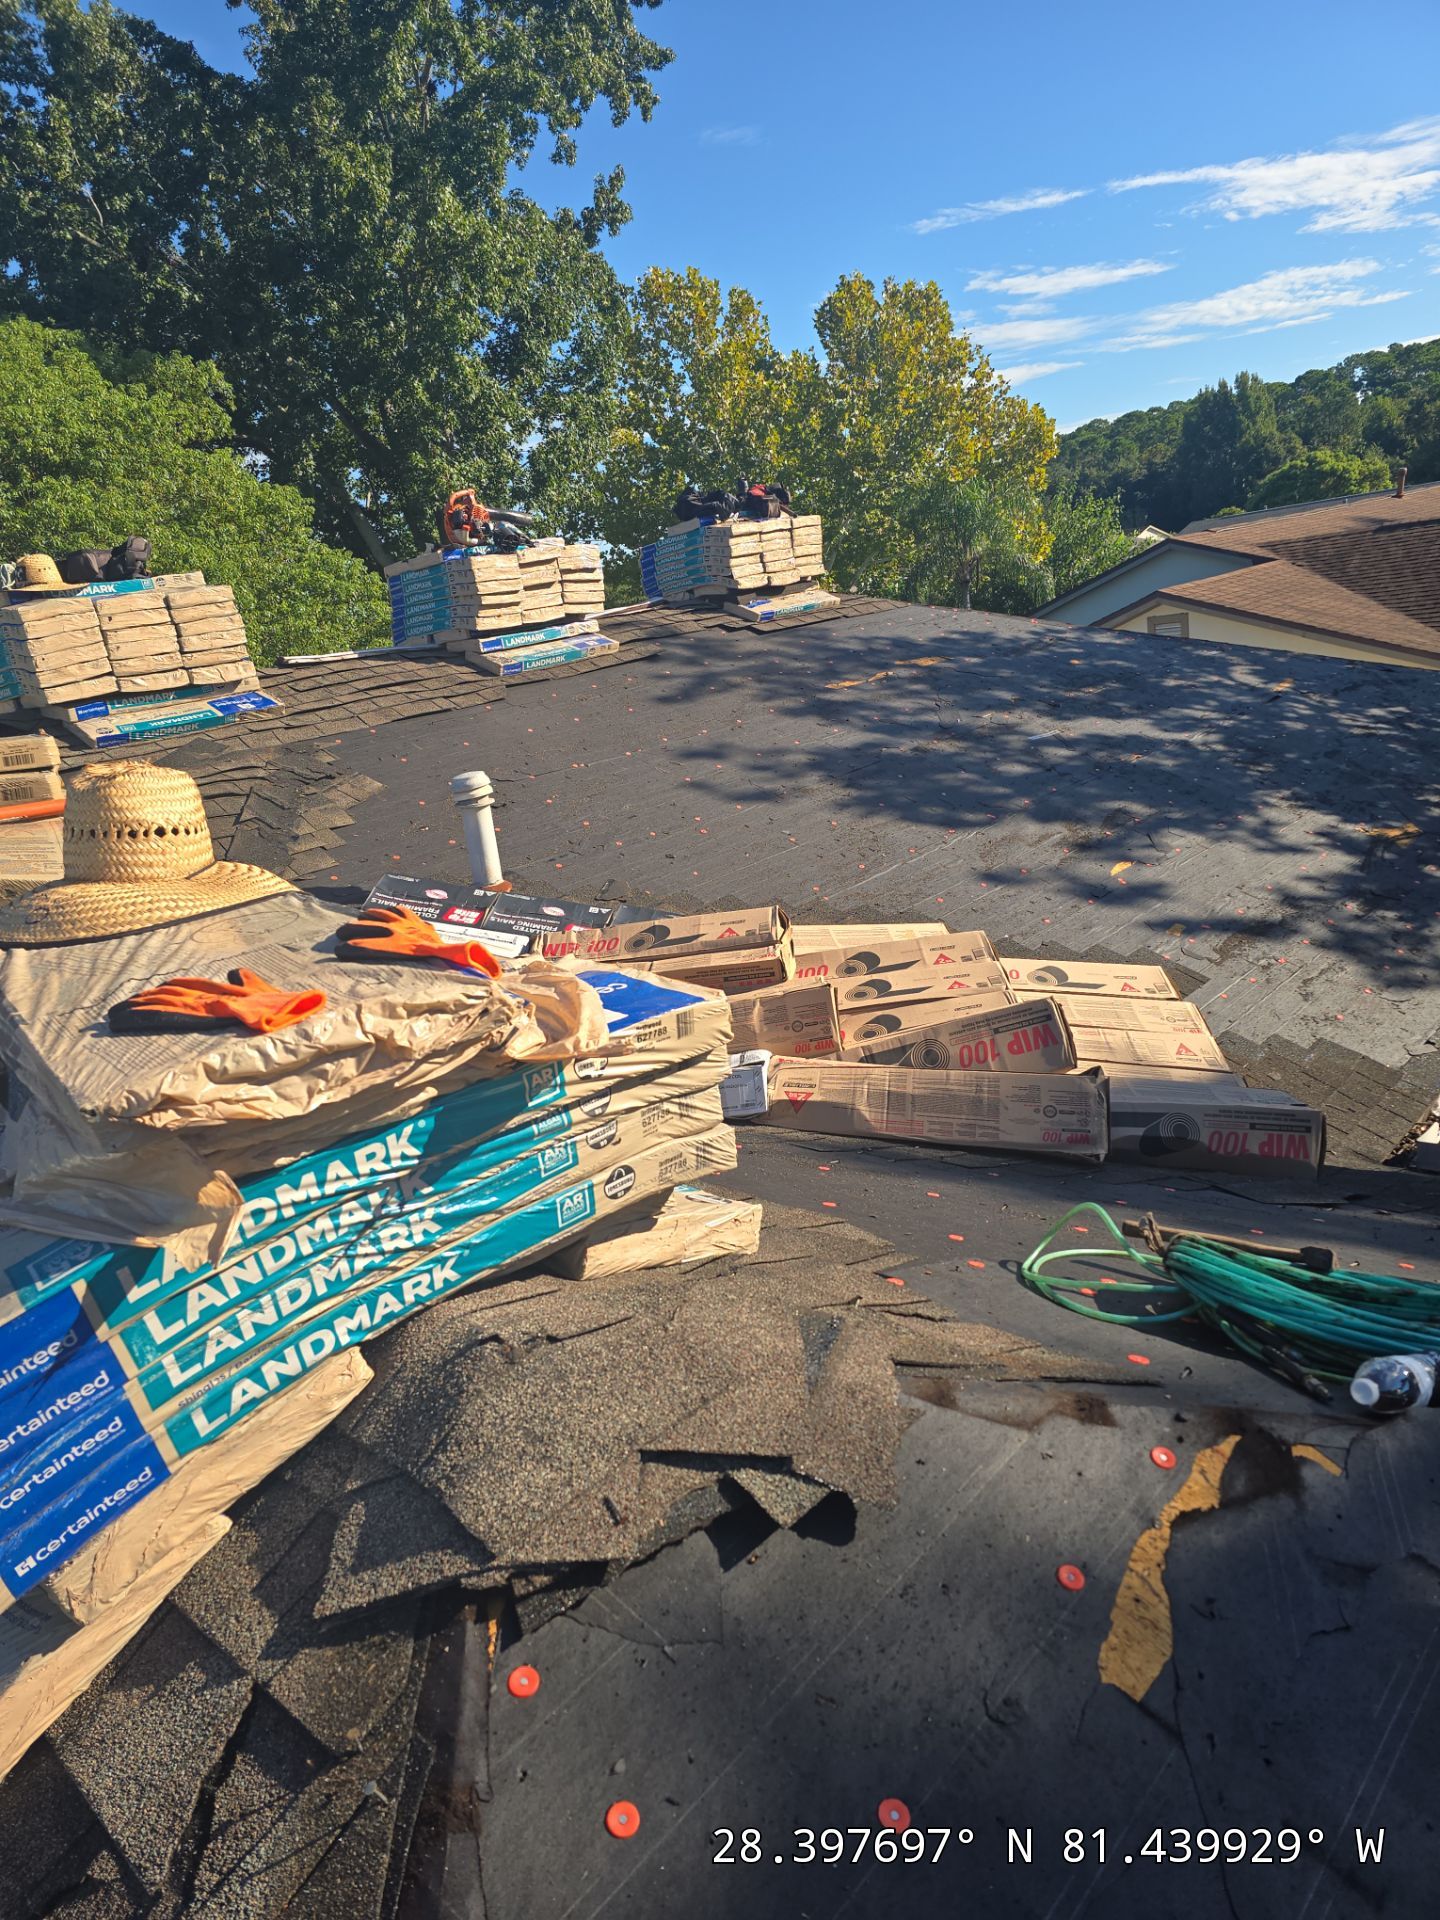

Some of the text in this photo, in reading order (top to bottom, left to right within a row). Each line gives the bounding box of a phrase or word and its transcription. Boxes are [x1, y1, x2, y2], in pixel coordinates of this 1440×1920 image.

[505, 632, 546, 647] LANDMARK
[526, 655, 566, 669] LANDMARK
[114, 691, 177, 708] LANDMARK
[135, 722, 200, 738] LANDMARK
[371, 897, 396, 907] NAILS
[491, 916, 516, 925] NAILS
[516, 920, 559, 932] FRAMING
[794, 1039, 835, 1055] WIP 100
[1006, 1023, 1059, 1056] WIP
[959, 1038, 1003, 1069] 100
[531, 1070, 554, 1088] AR
[1042, 1130, 1091, 1145] WIP 100
[1207, 1130, 1311, 1160] WIP 100
[562, 1192, 585, 1210] AR
[116, 1122, 422, 1304] LADMARK
[142, 1167, 435, 1345] LANDMARK
[161, 1207, 443, 1388] LANDMARK
[190, 1253, 462, 1437] LANDMARK
[0, 1416, 123, 1511] certainteed
[35, 1466, 153, 1562] certainteed
